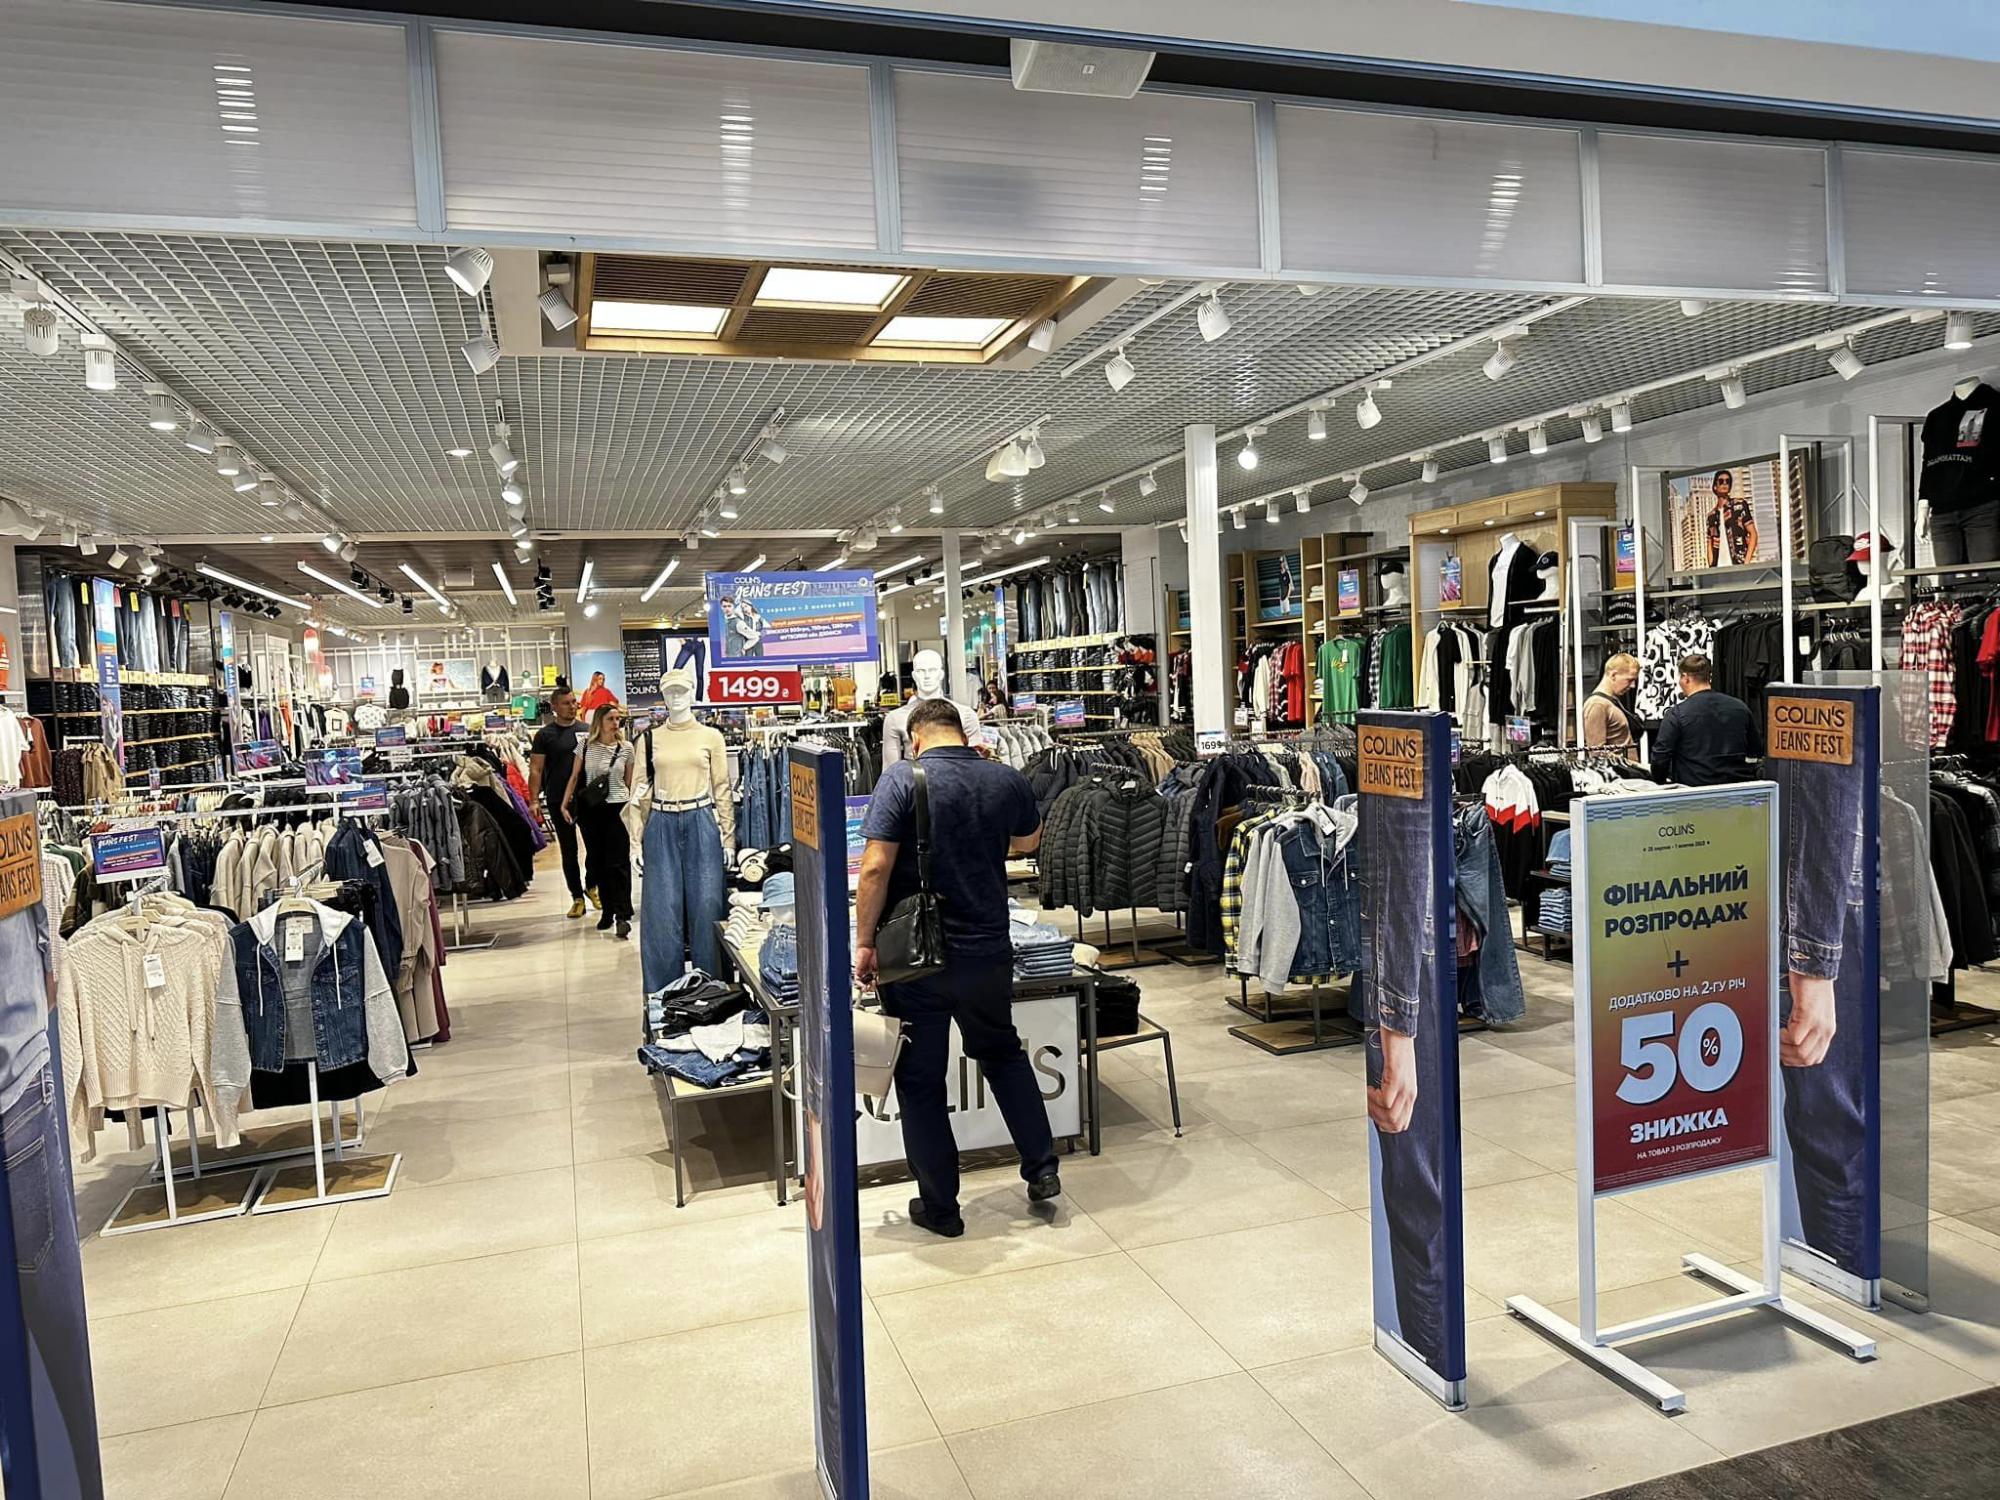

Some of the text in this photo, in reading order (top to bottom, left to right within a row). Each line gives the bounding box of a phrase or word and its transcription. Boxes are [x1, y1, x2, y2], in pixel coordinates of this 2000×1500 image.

[734, 576, 761, 584] COLIN'S
[734, 580, 810, 605] JEANS FEST
[718, 676, 780, 698] 1499
[1773, 705, 1845, 728] COLIN'S
[1363, 735, 1417, 759] COLIN'S
[1775, 730, 1844, 757] JEANS FEST
[1364, 763, 1416, 790] JEANS FEST
[119, 834, 139, 843] FEST
[1658, 823, 1695, 838] COLIN'S
[18, 864, 36, 896] FEST
[1603, 864, 1748, 906] ФІНАЛЬНИЙ
[1605, 901, 1749, 938] РОЗПРОДАЖ
[1608, 978, 1746, 1011] ДОДАТКОВО НА 2-ГУ РІЧ
[1630, 1108, 1729, 1145] ЗНИЖКА
[1637, 1150, 1647, 1160] НА
[1648, 1147, 1671, 1158] ТОВАР
[1676, 1136, 1722, 1152] РОЗПРОДАЖУ
